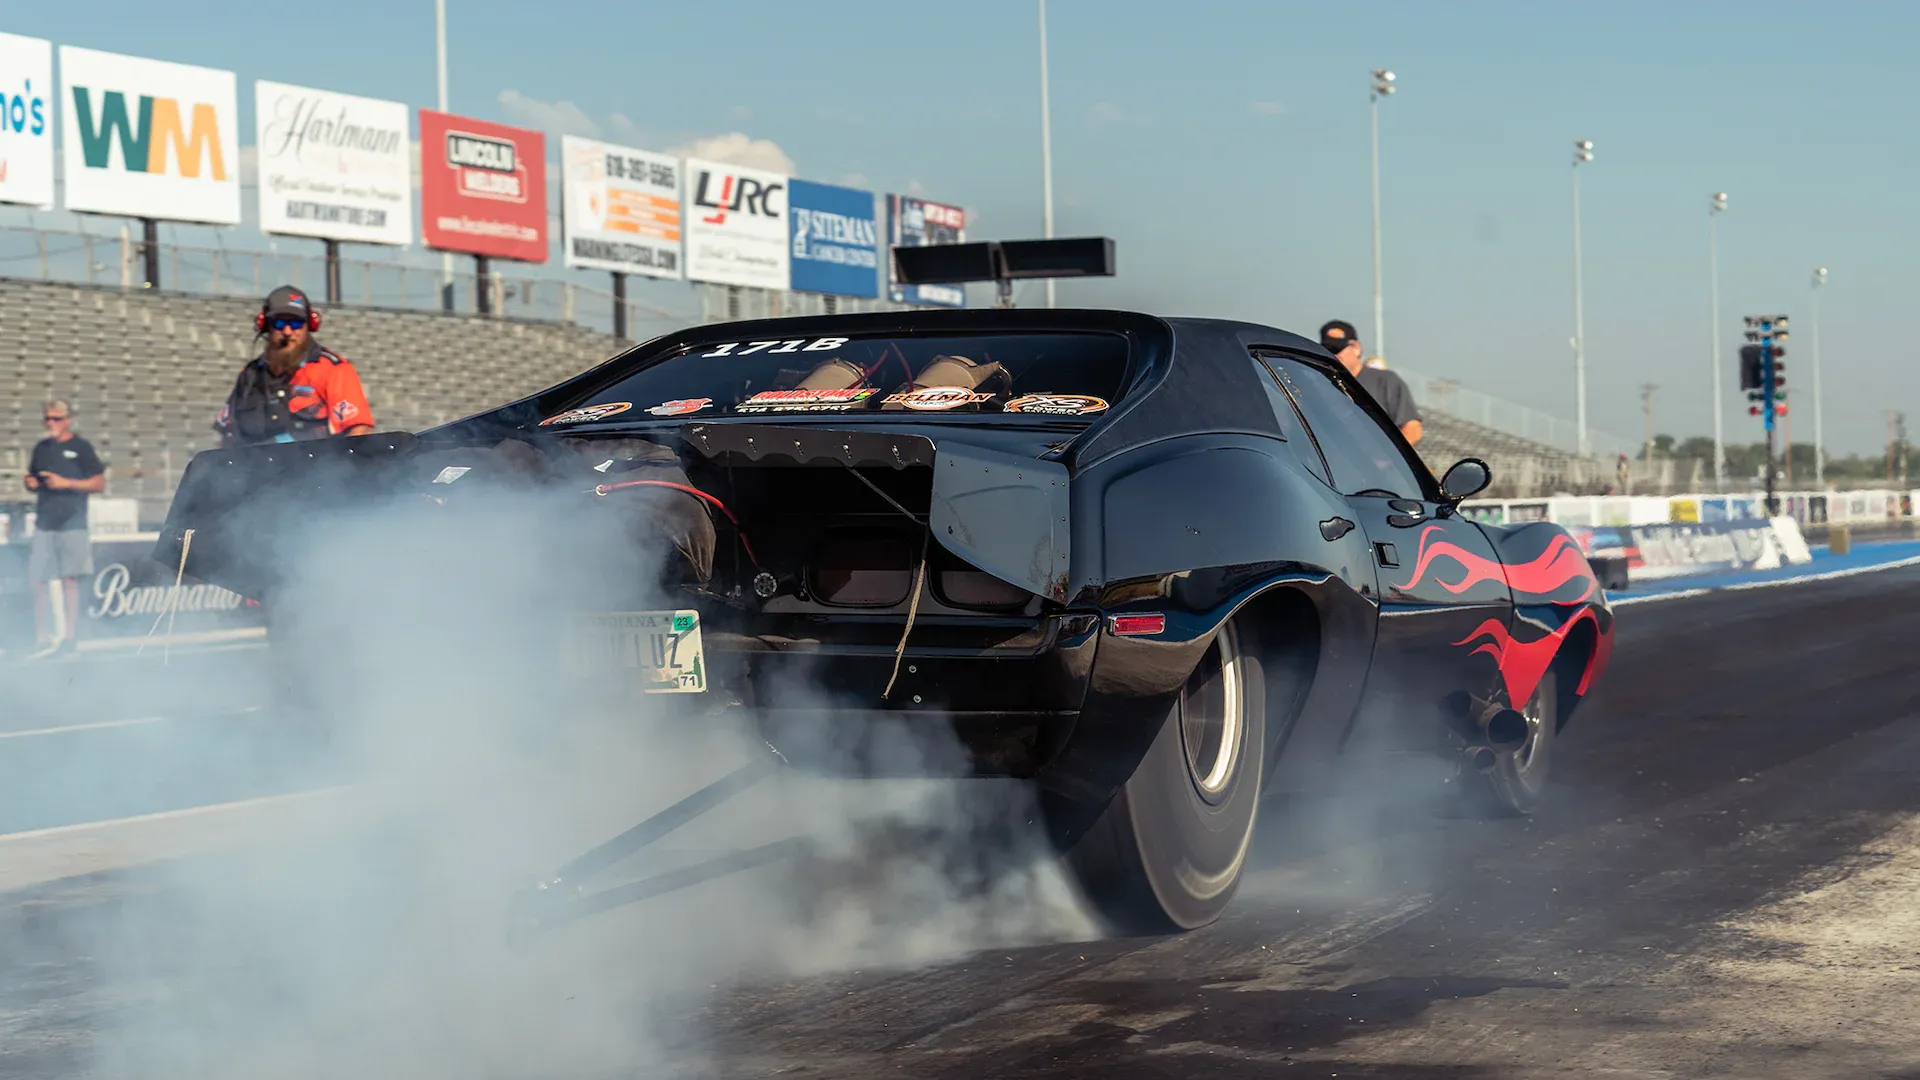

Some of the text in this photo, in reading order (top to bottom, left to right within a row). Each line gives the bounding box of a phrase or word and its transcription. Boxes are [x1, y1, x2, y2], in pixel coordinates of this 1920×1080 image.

[72, 86, 227, 181] WM
[264, 94, 401, 162] Hartmann
[449, 138, 513, 170] LINCOLN
[464, 168, 521, 196] WELDERS
[812, 210, 876, 246] SITEMAN
[701, 338, 849, 358] 171B
[676, 617, 688, 626] 23
[680, 676, 696, 686] 71
